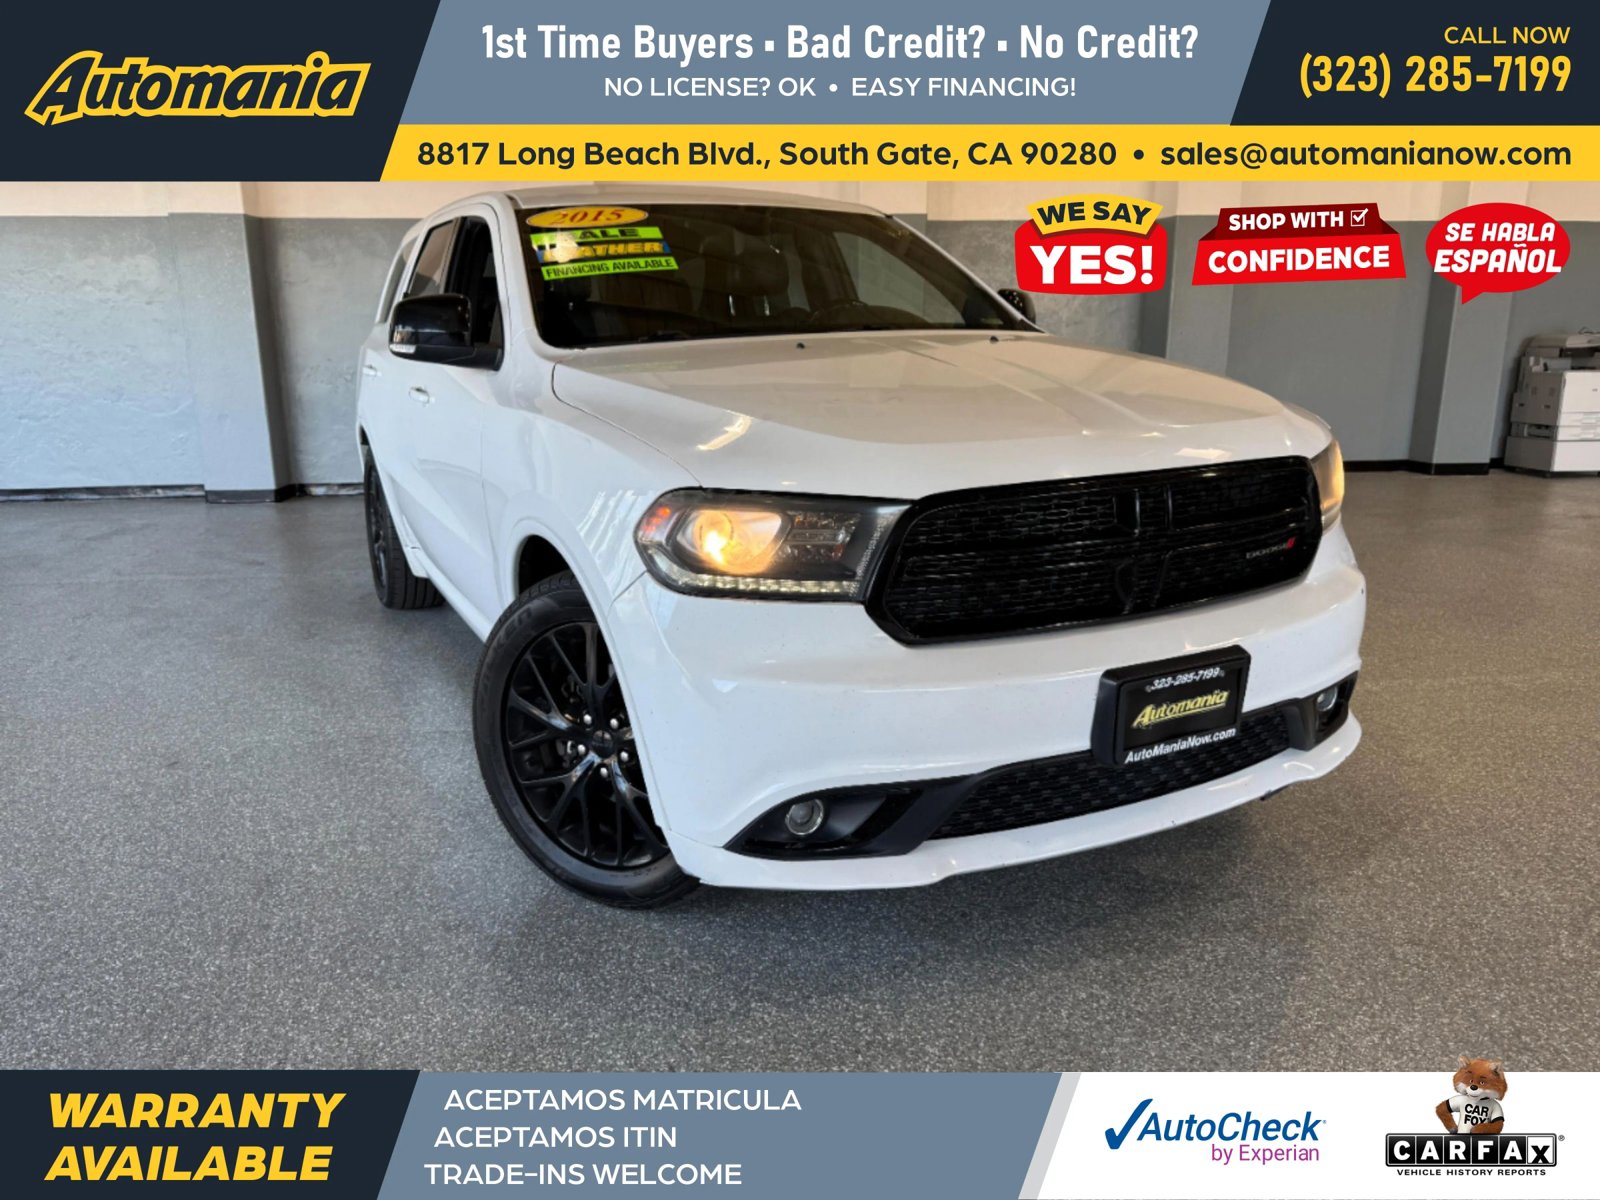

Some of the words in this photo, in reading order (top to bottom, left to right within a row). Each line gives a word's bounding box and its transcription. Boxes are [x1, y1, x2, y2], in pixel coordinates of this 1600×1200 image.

[549, 208, 626, 226] 2015
[563, 228, 640, 241] ALE
[545, 262, 610, 278] FINANCING
[612, 258, 674, 271] AVAILABLE
[1150, 667, 1221, 691] 323-285-7199
[1131, 689, 1231, 728] Automania
[1124, 728, 1237, 764] AutoManiaNow.com
